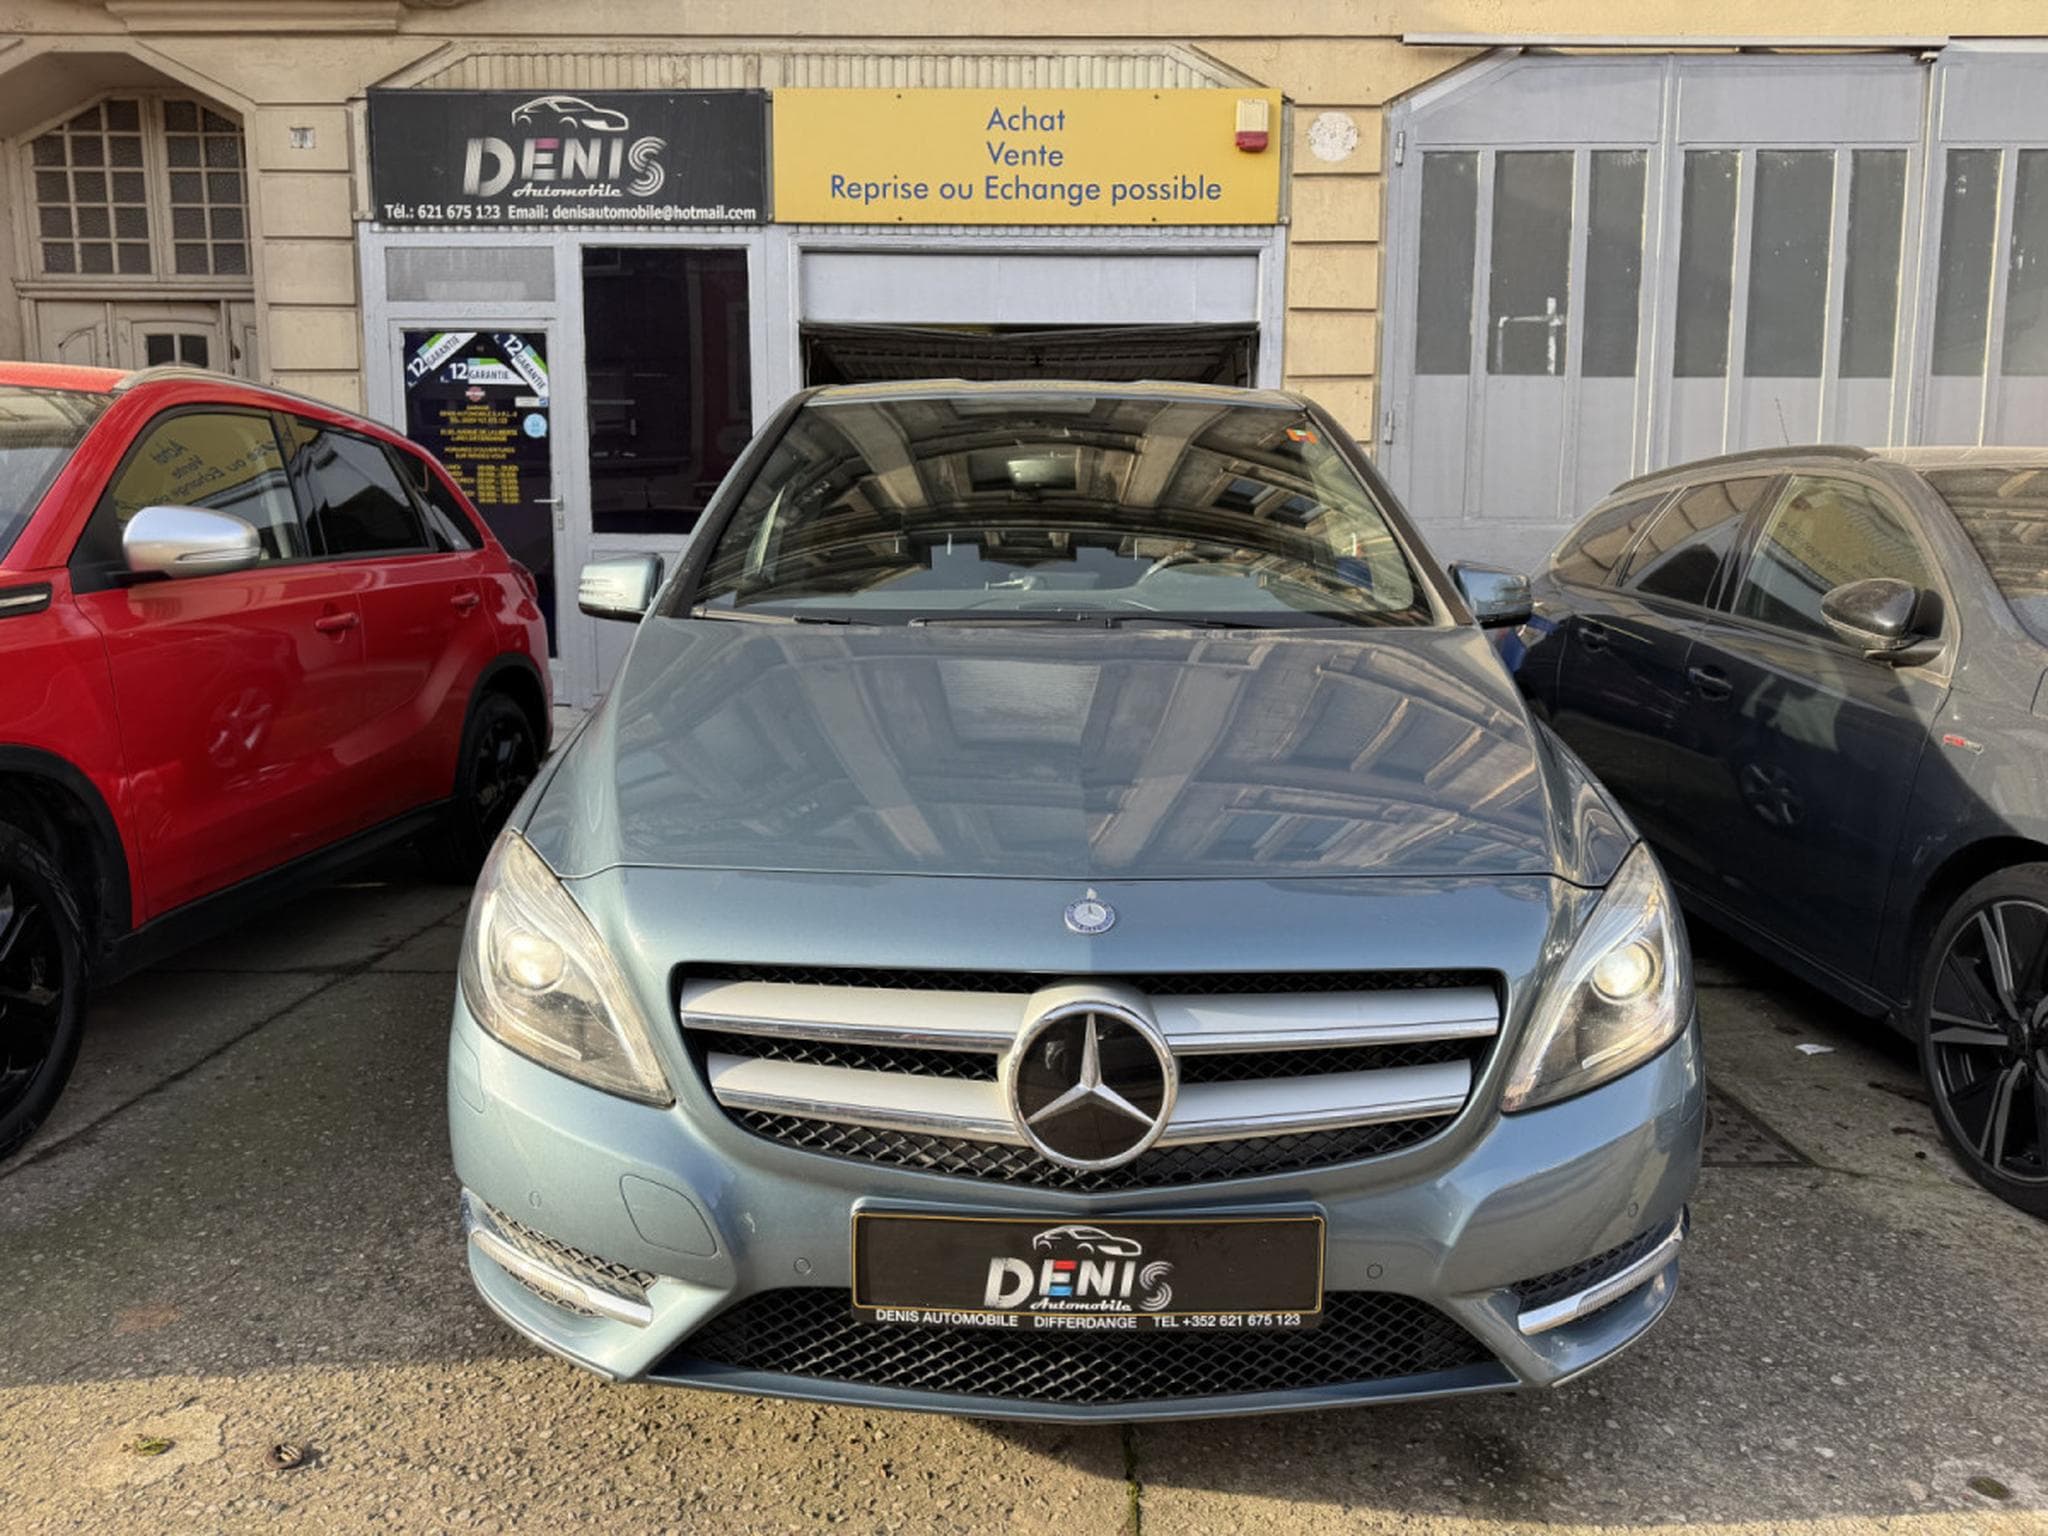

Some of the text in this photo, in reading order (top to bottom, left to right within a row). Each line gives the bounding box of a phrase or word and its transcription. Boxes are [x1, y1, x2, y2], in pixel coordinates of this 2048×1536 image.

[987, 106, 1065, 131] Achat
[986, 141, 1064, 167] Vente
[463, 136, 668, 198] DENIS
[512, 183, 623, 198] Automobile
[831, 175, 1222, 206] Reprise ou Echange possible
[384, 203, 756, 220] Tél.: 621 675 123 Email: denisautomobile@hotmail.com
[407, 335, 460, 377] 12 GARANTIE
[504, 334, 522, 356] 12
[515, 354, 546, 389] GARANTIE
[449, 363, 509, 380] 12 GARANTIE
[984, 1257, 1174, 1311] DENIS
[1030, 1297, 1132, 1312] Automobile
[876, 1309, 1301, 1329] DENIS AUTOMOBILE DIFFERDANGE TEL +352 621 675 123
